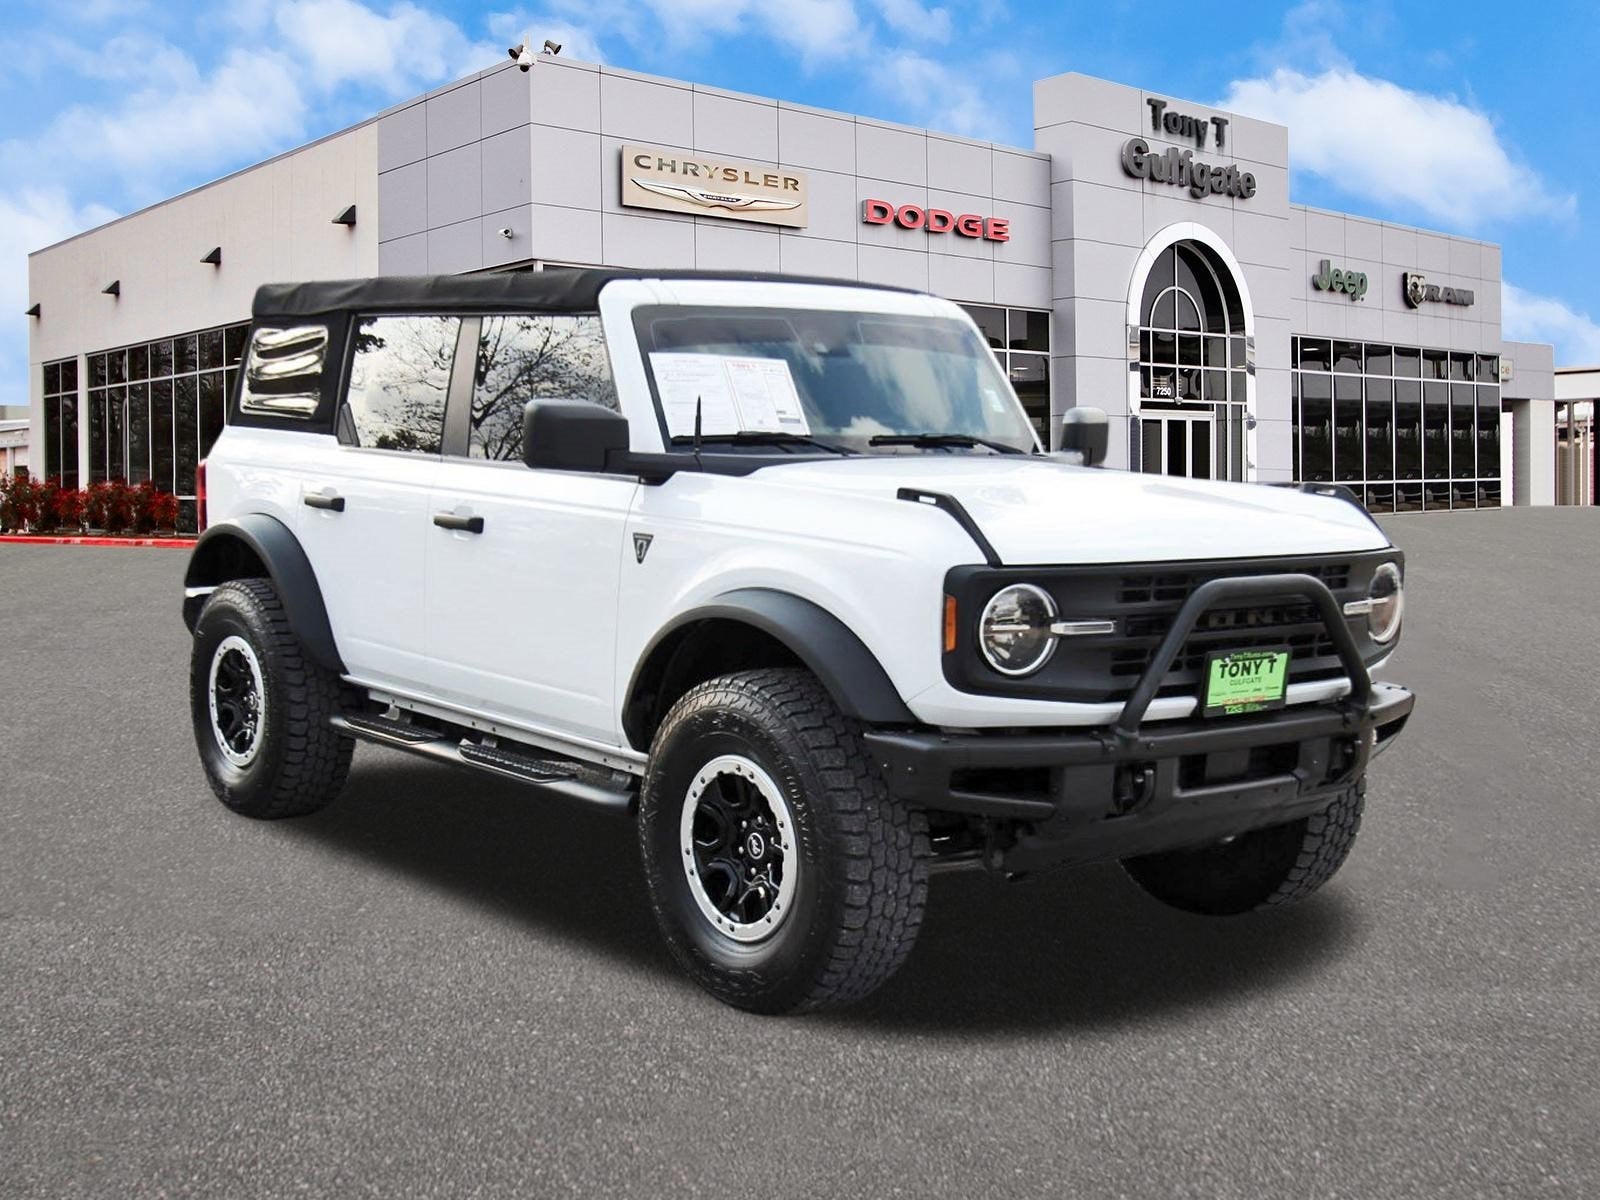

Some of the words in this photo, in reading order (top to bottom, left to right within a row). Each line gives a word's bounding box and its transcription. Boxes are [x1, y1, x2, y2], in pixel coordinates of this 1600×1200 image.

[1147, 98, 1208, 148] Tony
[1211, 117, 1229, 147] T
[633, 153, 800, 192] CHRYSLER
[1121, 138, 1256, 199] Gulfgate
[862, 198, 1010, 242] DODGE
[1313, 260, 1368, 301] Jeep
[1425, 284, 1475, 306] RAM
[1156, 387, 1171, 396] 7250
[1219, 660, 1263, 679] TONY
[1268, 658, 1277, 673] T
